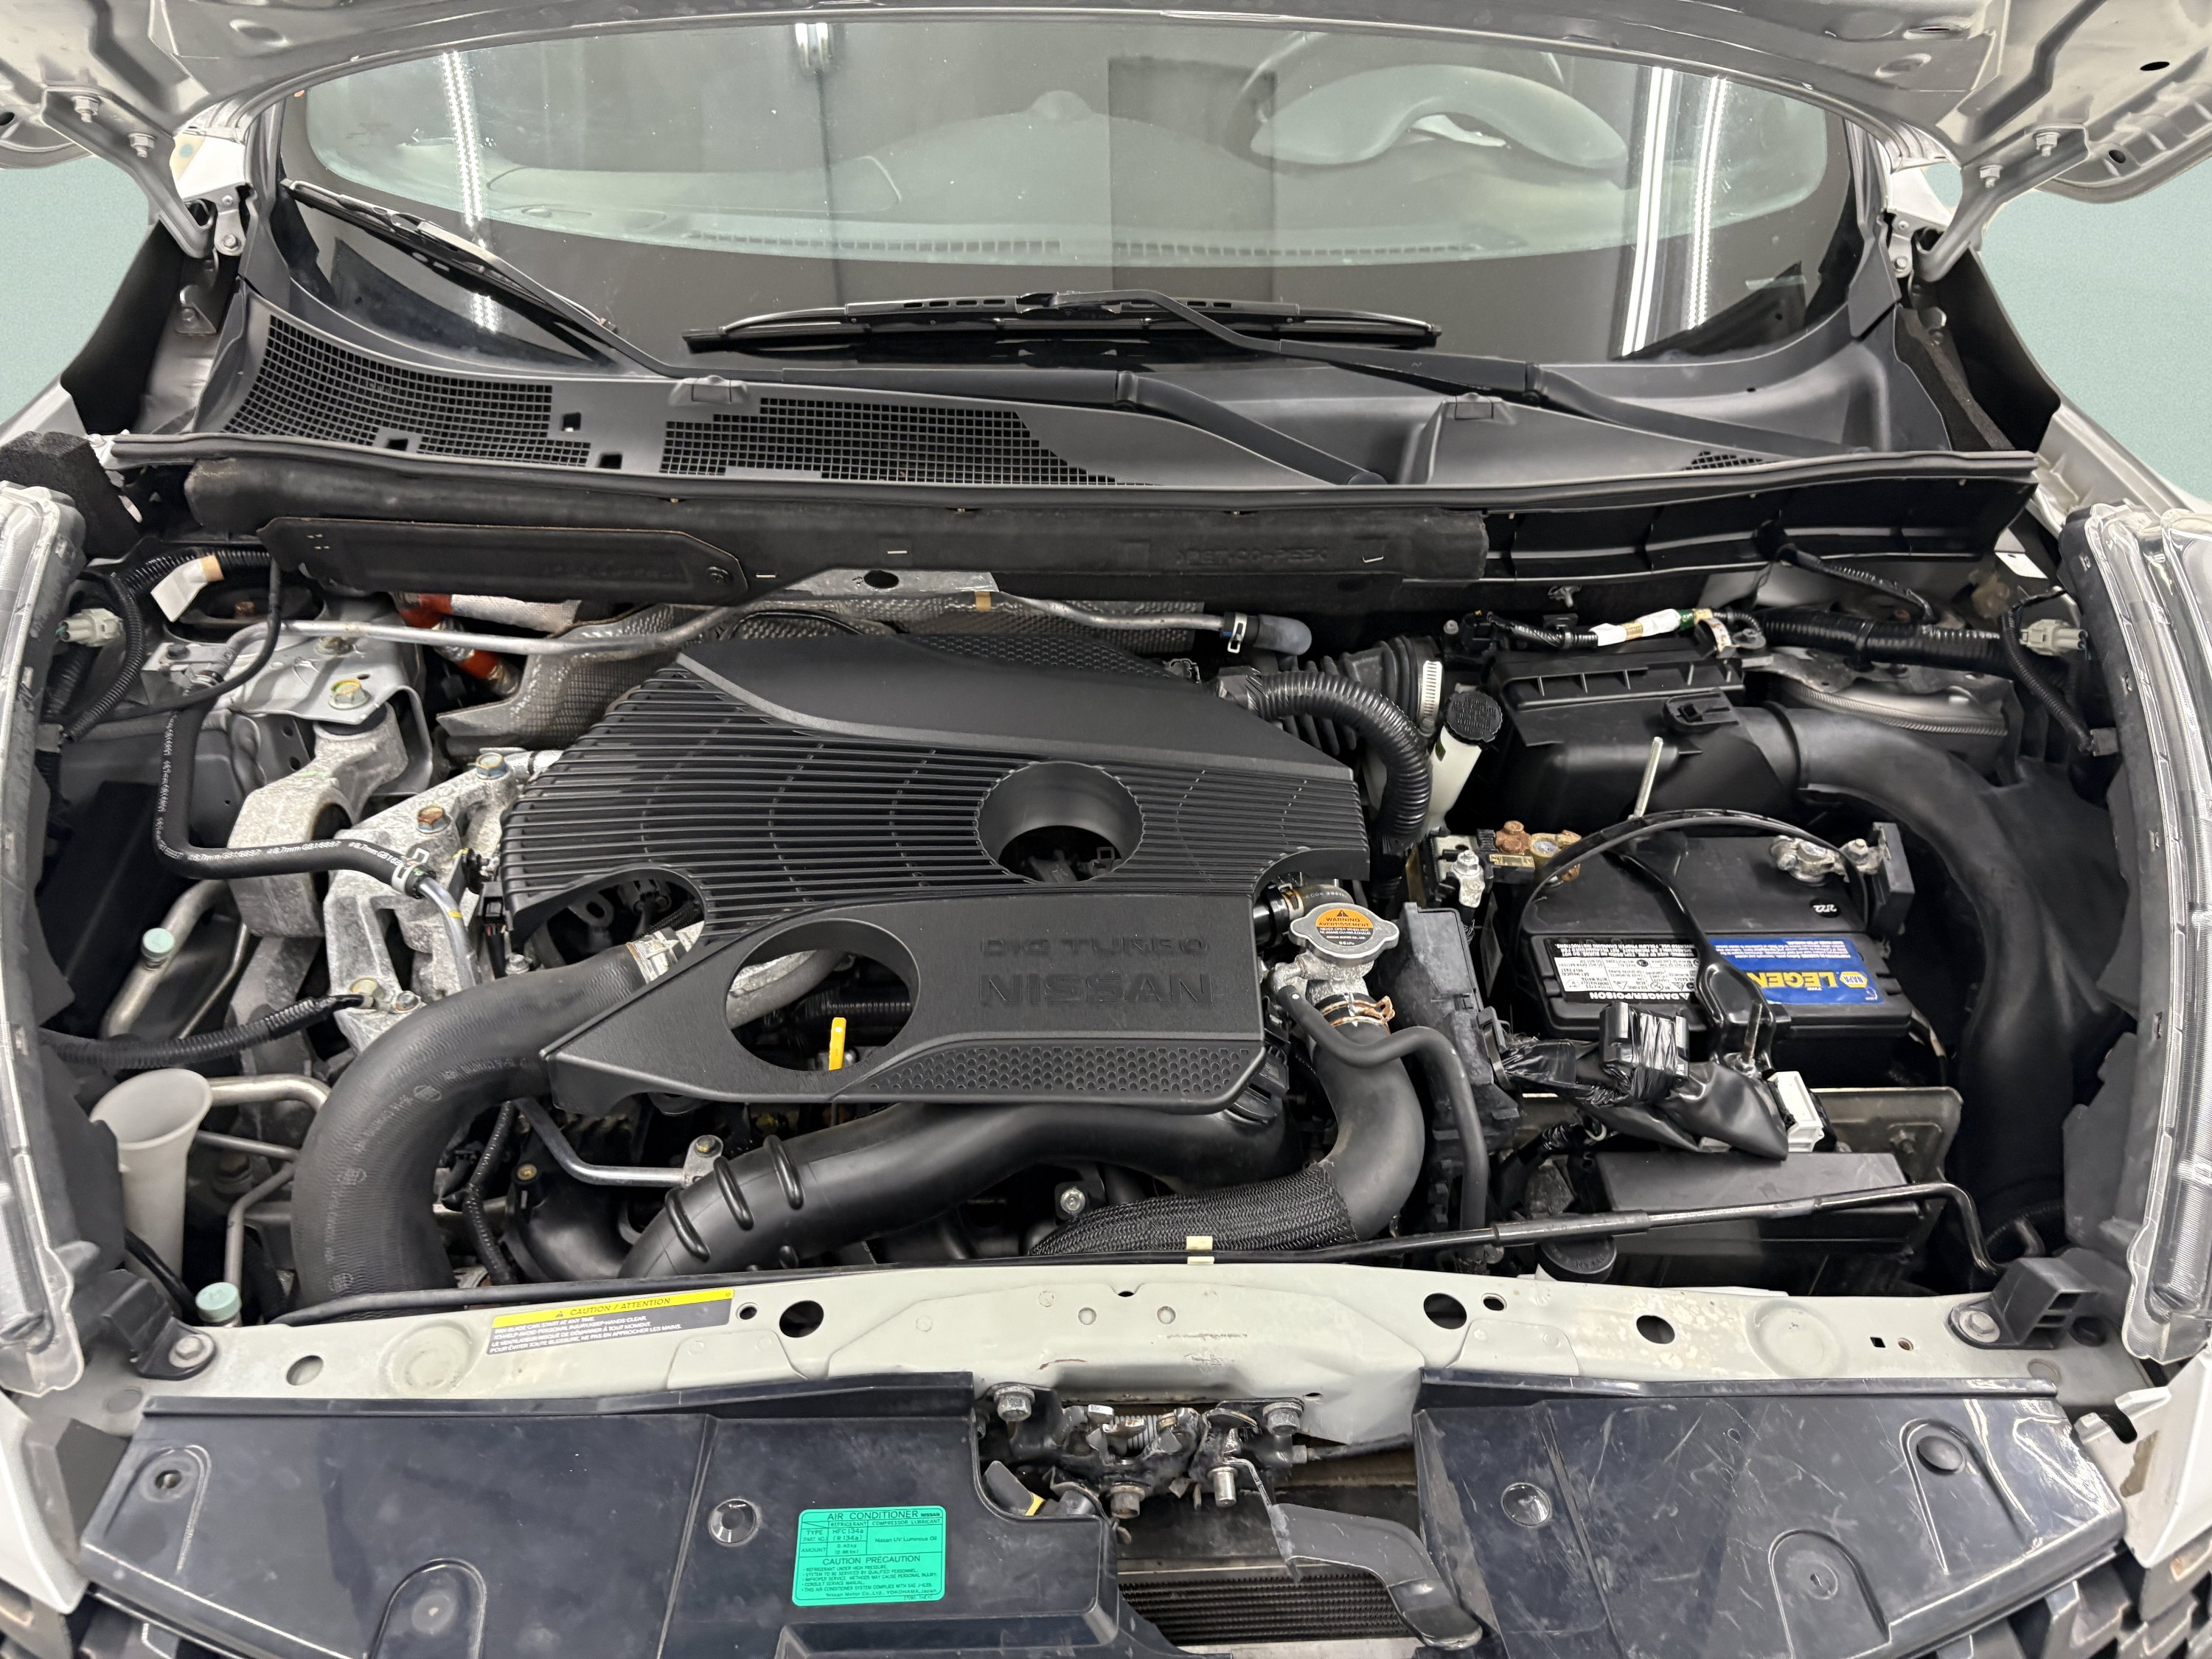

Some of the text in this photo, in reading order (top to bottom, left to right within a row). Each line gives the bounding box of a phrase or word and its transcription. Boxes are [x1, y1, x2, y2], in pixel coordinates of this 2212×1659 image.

[1060, 936, 1208, 956] TURBO
[1746, 972, 1837, 988] LEGEN
[980, 973, 1213, 1004] NISSAN
[570, 1305, 611, 1315] CAUTION
[620, 1298, 670, 1310] ATTENTION
[827, 1510, 918, 1520] AIR CONDITIONER
[822, 1555, 921, 1565] CAUTION PRECAUTION
